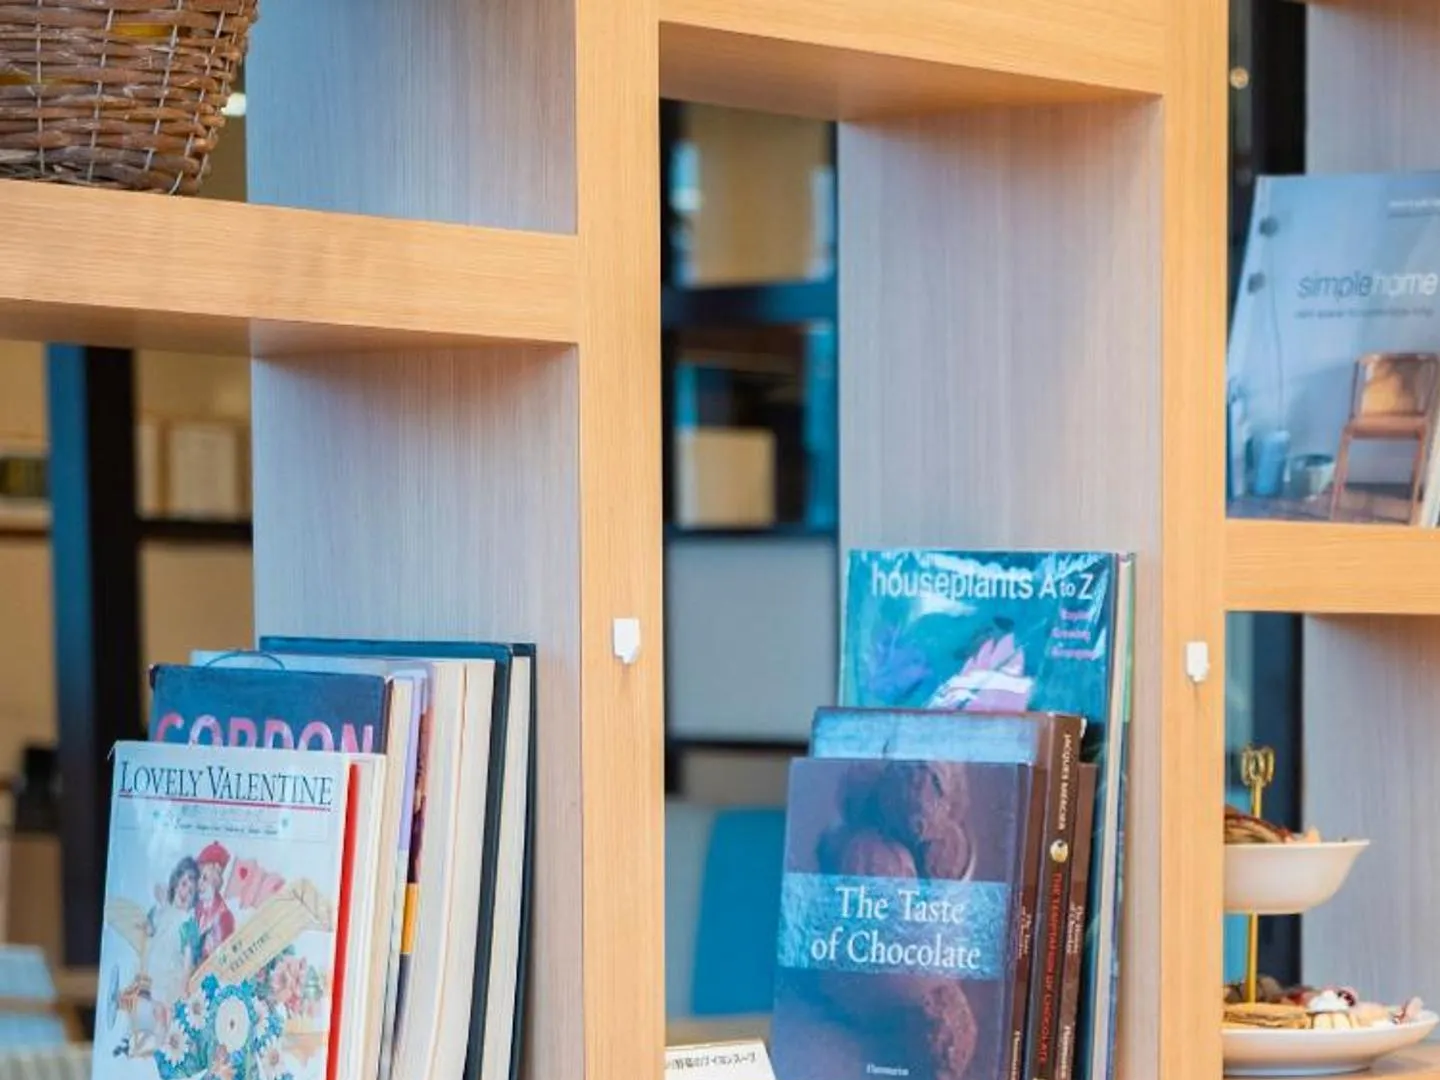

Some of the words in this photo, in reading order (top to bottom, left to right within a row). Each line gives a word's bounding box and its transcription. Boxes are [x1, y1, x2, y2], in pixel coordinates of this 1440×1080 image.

[871, 560, 1034, 602] houseplants
[1039, 572, 1059, 599] A
[1060, 581, 1076, 598] to
[1077, 573, 1094, 600] Z
[119, 761, 203, 797] LOVELY
[206, 763, 334, 806] VALENTINE
[835, 885, 889, 920] The
[898, 888, 966, 925] Taste
[811, 926, 844, 961] of
[847, 929, 982, 970] Chocolate
